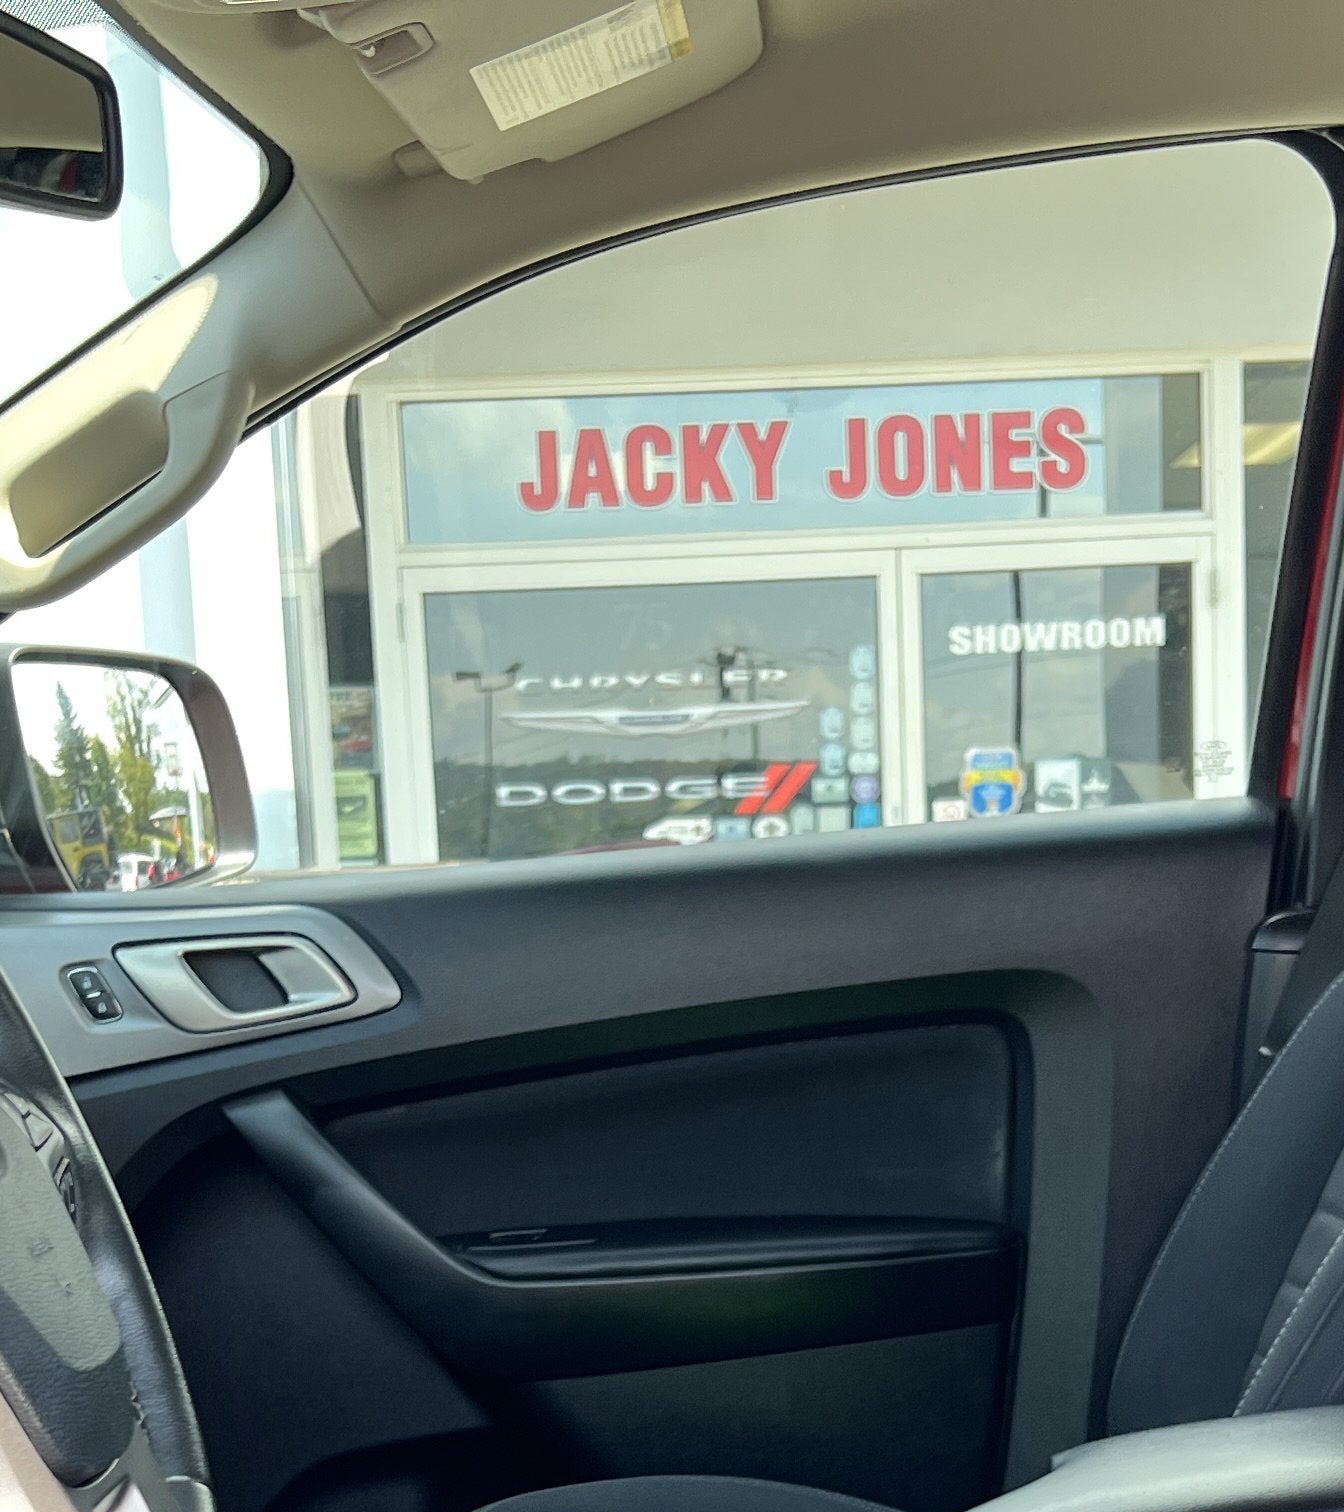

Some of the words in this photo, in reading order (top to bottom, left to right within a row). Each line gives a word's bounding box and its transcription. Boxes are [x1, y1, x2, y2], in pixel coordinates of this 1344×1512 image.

[519, 419, 791, 513] JACKY
[827, 407, 1087, 499] JONES
[948, 615, 1168, 656] SHOWROOM
[496, 774, 769, 807] DODGE
